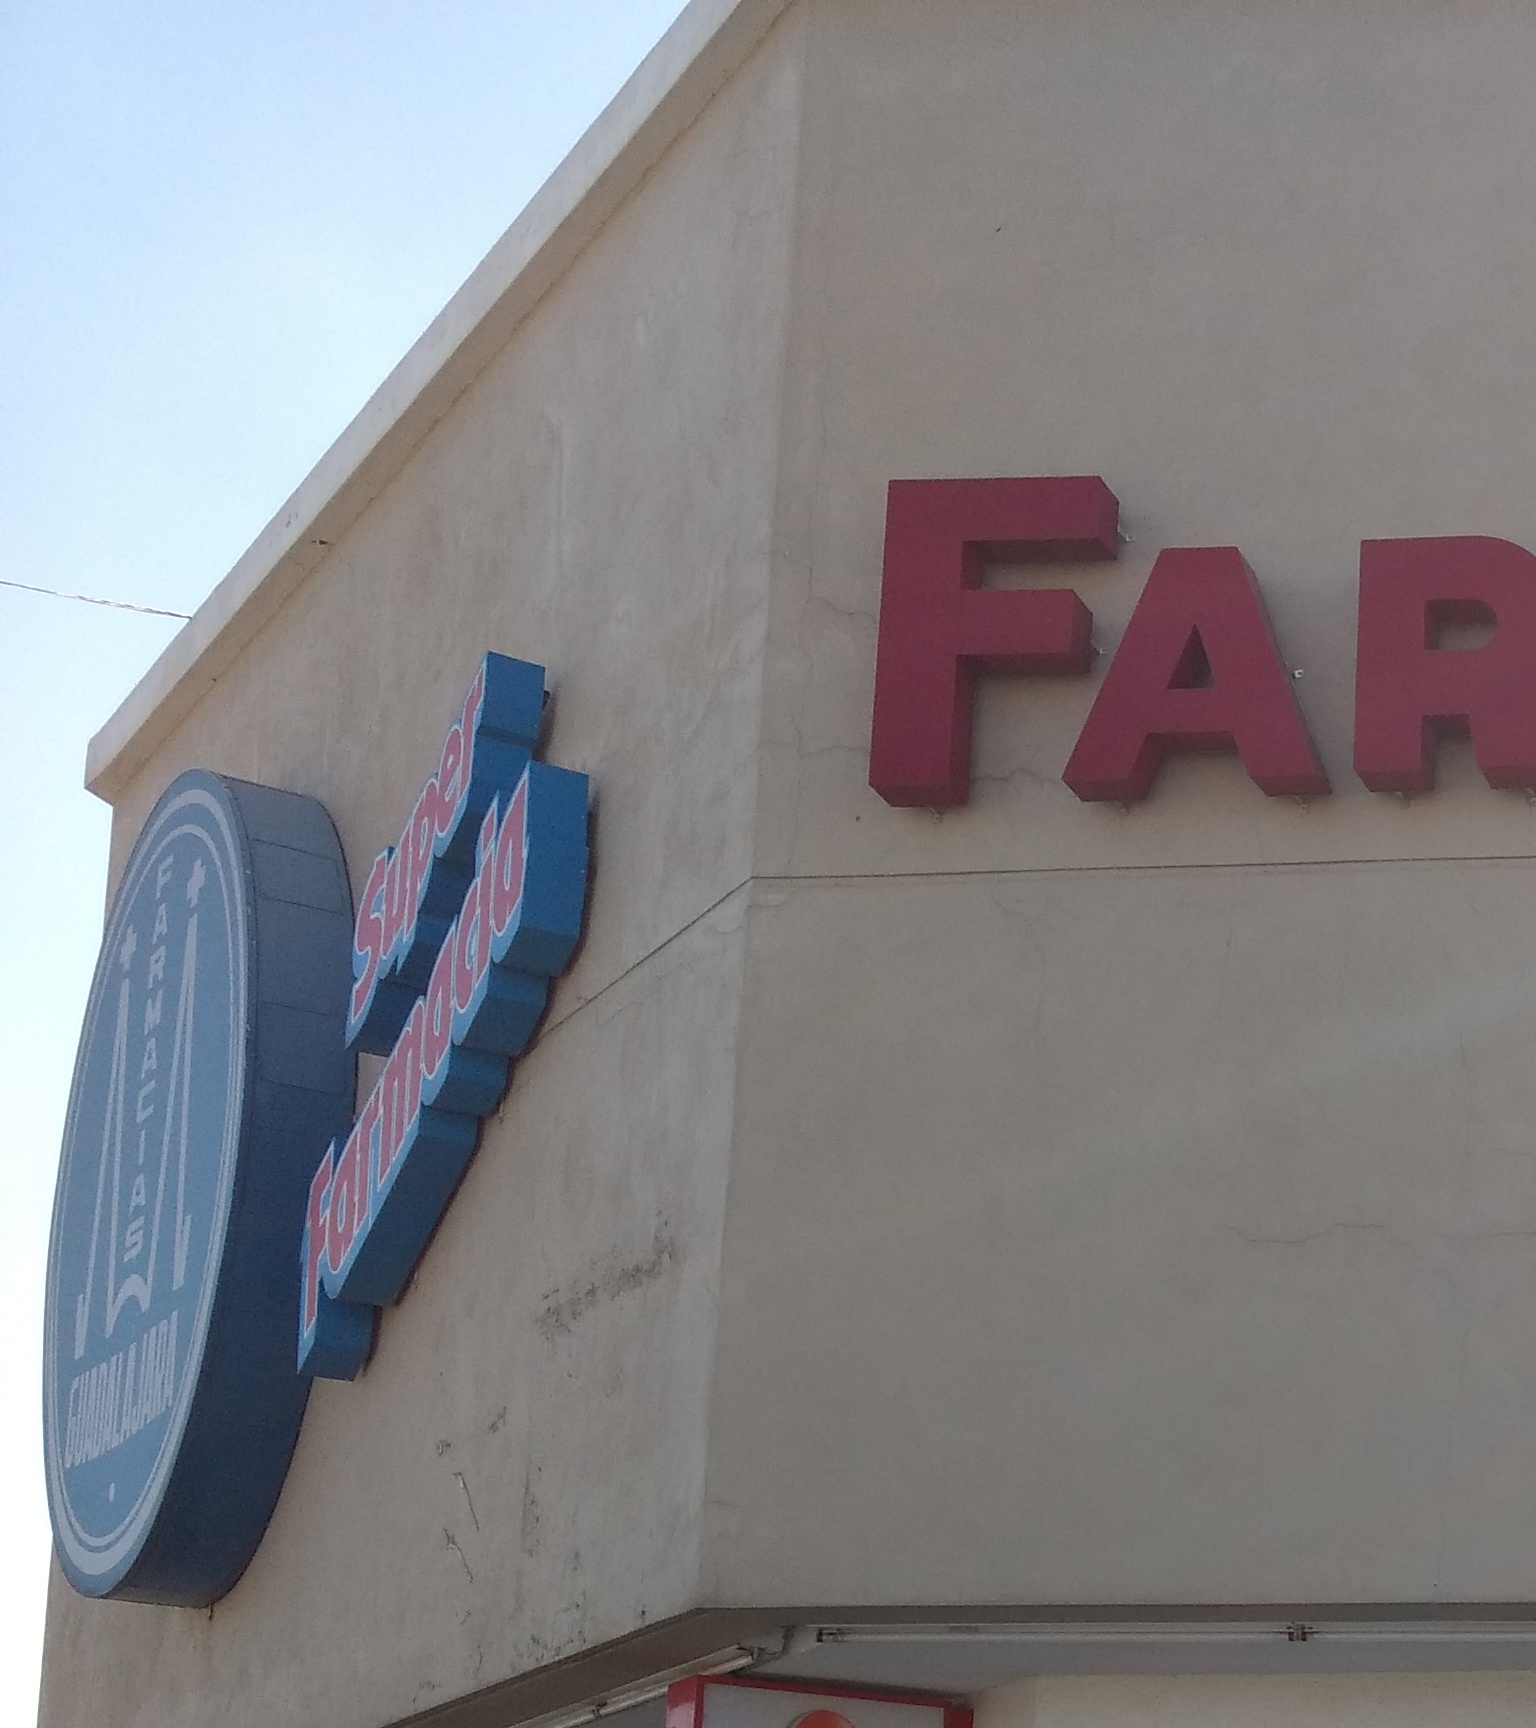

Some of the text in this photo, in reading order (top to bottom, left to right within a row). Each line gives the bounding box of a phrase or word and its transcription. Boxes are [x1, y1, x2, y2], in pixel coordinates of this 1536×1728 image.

[349, 660, 487, 1028] Super
[124, 854, 173, 1263] FARMACIAS
[302, 768, 529, 1343] Farmacia
